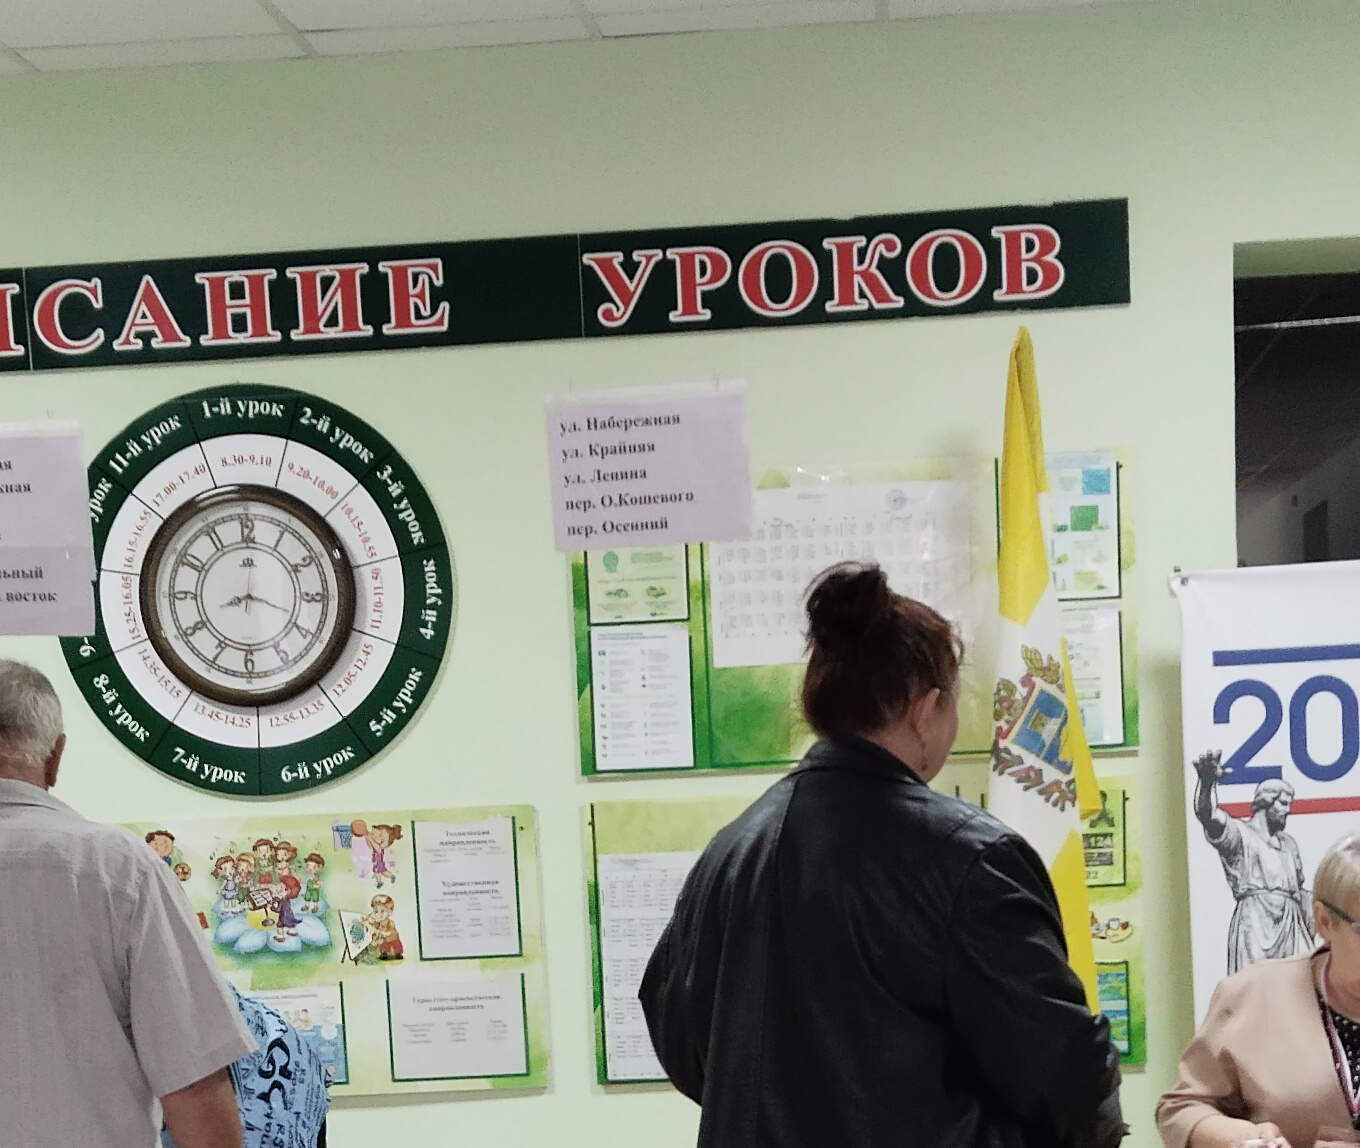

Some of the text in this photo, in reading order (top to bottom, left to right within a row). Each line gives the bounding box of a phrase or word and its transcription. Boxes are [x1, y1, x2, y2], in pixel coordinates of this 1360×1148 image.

[582, 224, 1066, 328] УРОКОВ
[202, 397, 285, 418] 1-й урок
[299, 407, 374, 464] 2-й урок
[560, 414, 680, 436] ул. Набережная
[109, 414, 182, 475] 11-й урок
[562, 442, 655, 463] ул. Крайняя
[564, 468, 647, 487] ул. Ленина
[377, 465, 426, 547] 3-й урок
[566, 491, 693, 512] пер. О.Кошевого
[240, 514, 255, 544] 12
[567, 517, 668, 537] пер. Осенний
[6, 592, 57, 602] восток
[419, 558, 442, 640] 4-й урок
[244, 649, 255, 673] 6
[93, 673, 150, 743] 8-й урок
[369, 667, 423, 737] 5-й урок
[172, 747, 246, 784] 7-й урок
[281, 745, 355, 782] 6-й урок
